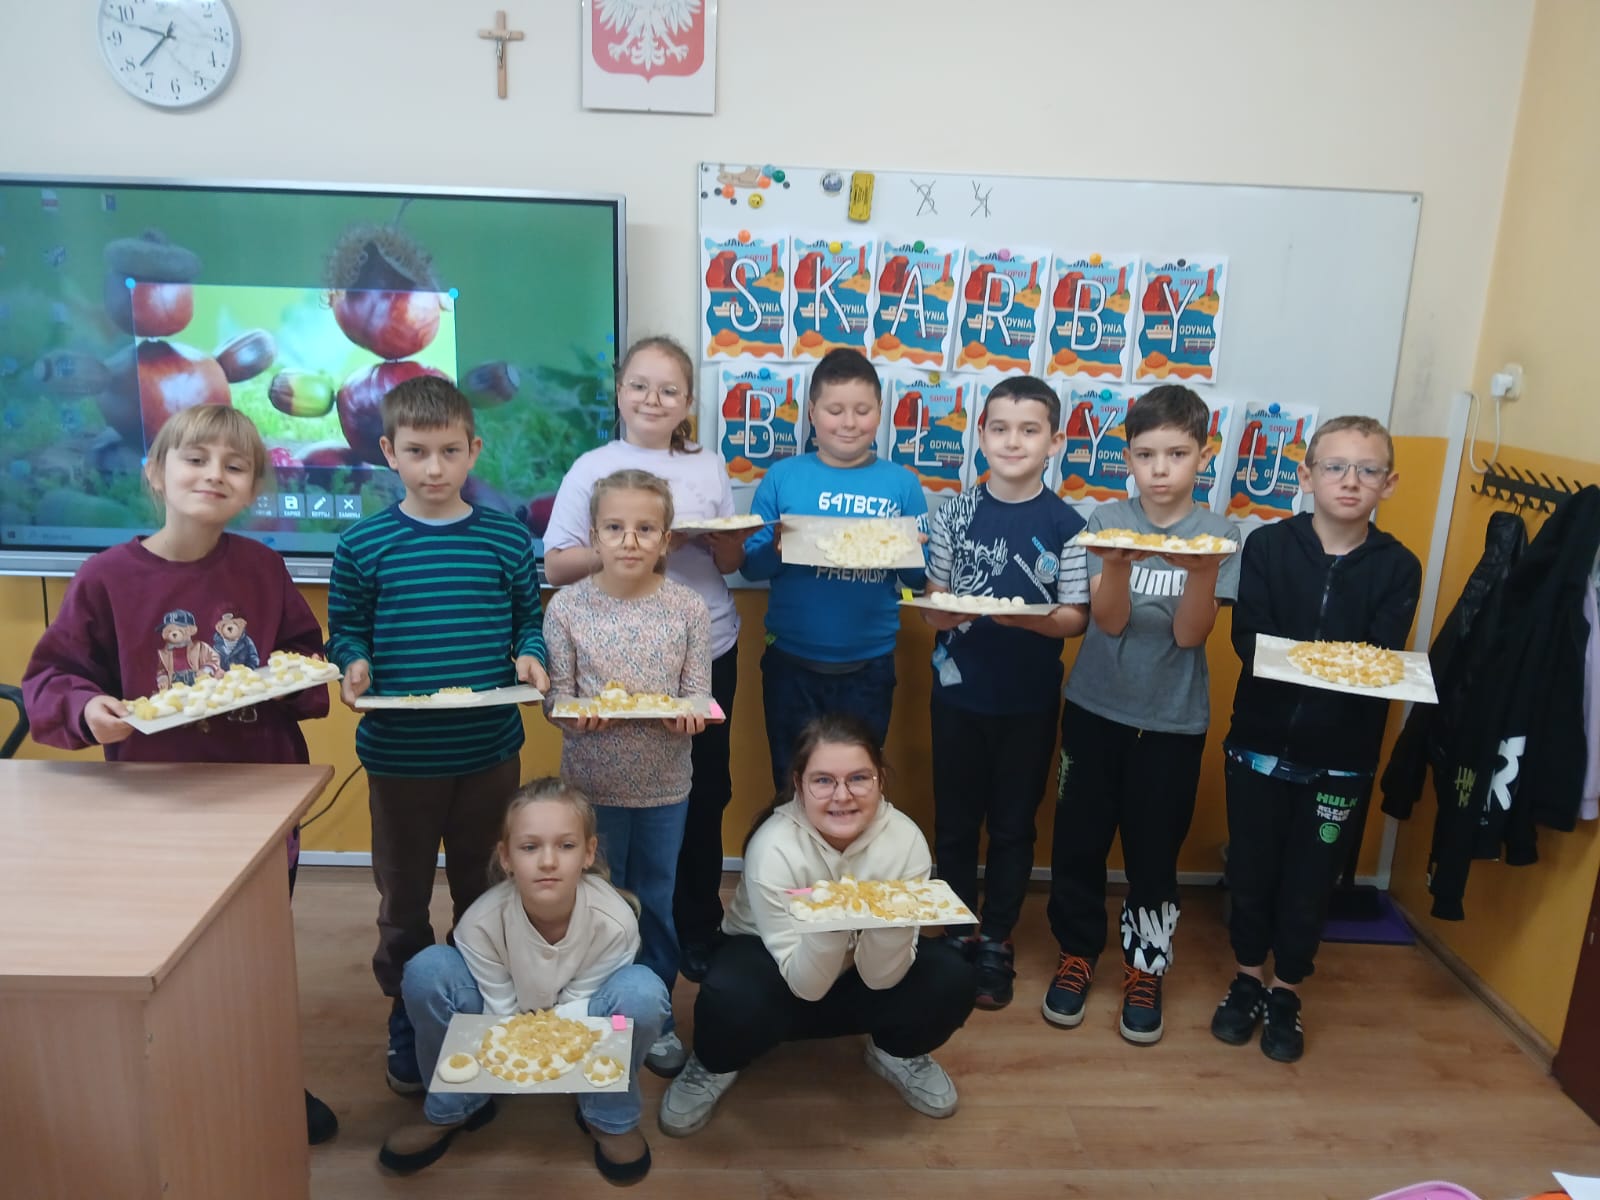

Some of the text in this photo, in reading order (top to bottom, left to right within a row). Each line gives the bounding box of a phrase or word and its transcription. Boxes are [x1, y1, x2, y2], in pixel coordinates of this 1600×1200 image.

[118, 5, 135, 22] 10
[112, 30, 123, 46] 9
[124, 56, 136, 72] 8
[145, 71, 154, 89] 7
[170, 78, 181, 94] 6
[193, 70, 204, 86] 5
[1090, 322, 1123, 334] GYNIA
[1179, 325, 1212, 336] GDYNIA
[762, 431, 793, 443] GYNIA
[929, 440, 961, 451] GDYNIA
[1129, 565, 1188, 597] UMA
[1316, 791, 1358, 807] HULK
